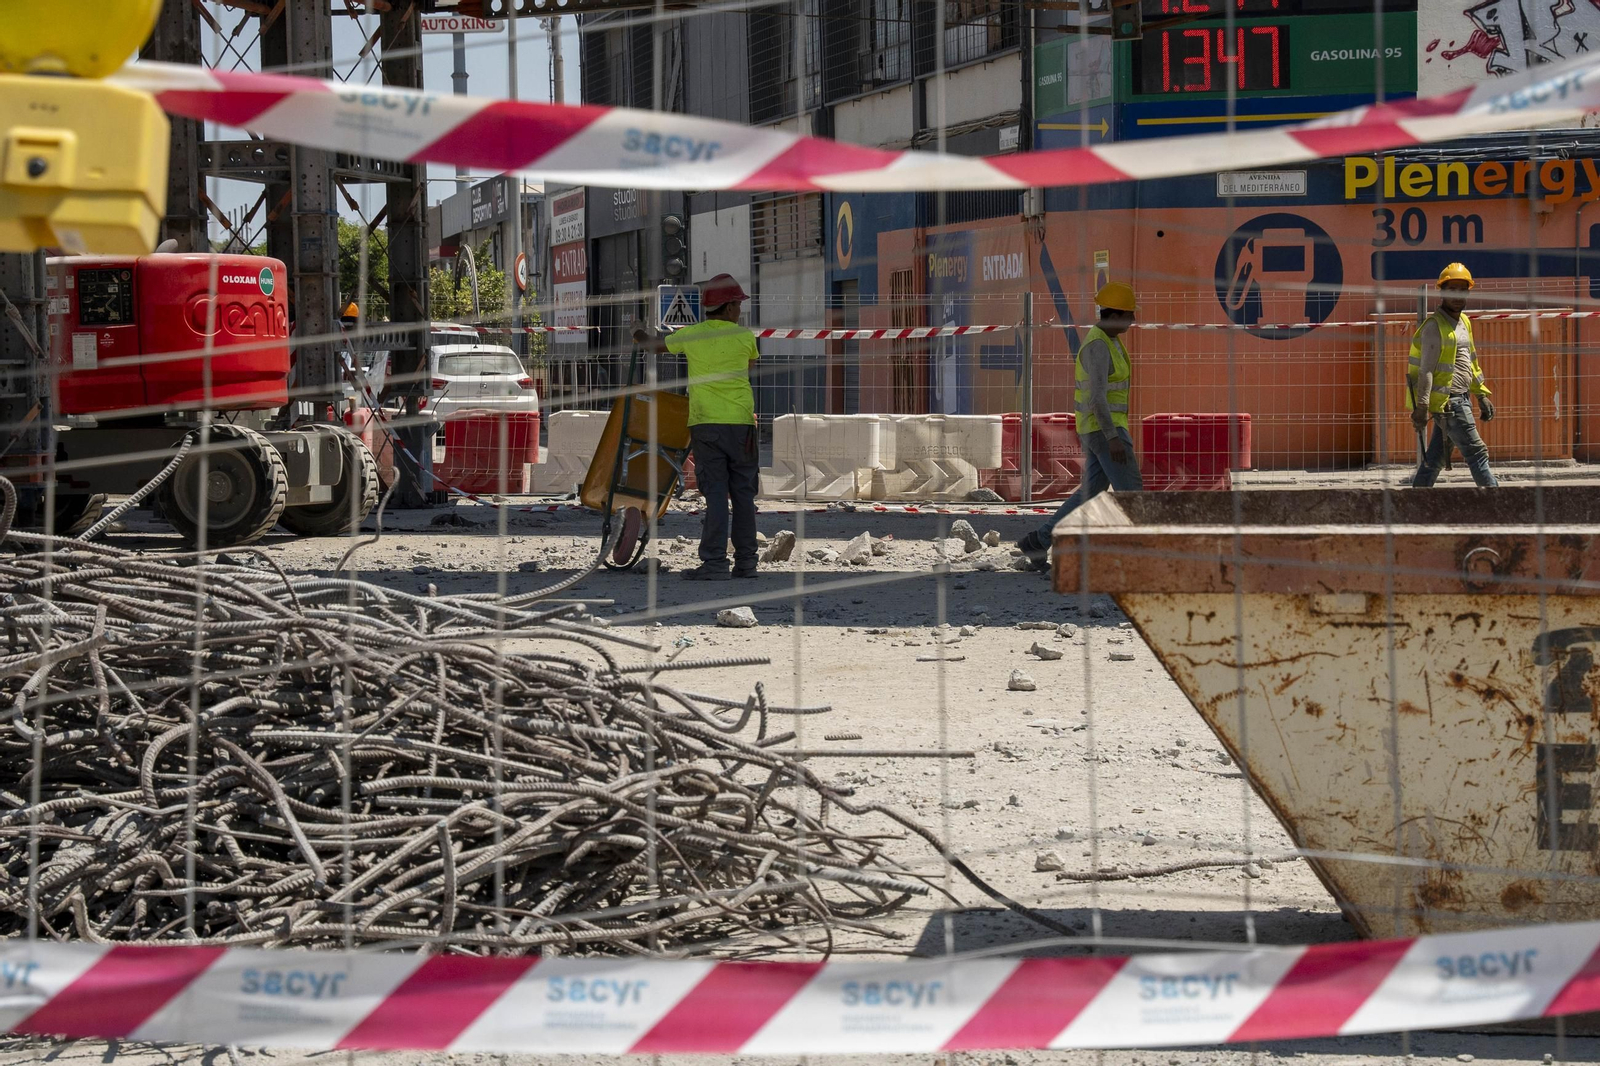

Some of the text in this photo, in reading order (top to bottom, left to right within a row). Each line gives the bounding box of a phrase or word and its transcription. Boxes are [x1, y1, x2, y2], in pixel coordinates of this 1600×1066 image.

[421, 17, 496, 31] AUTO KING
[1162, 27, 1280, 92] 1.347
[1310, 47, 1402, 61] GASOLINA 95
[1038, 73, 1057, 87] GASOLINA
[623, 128, 721, 163] sacyr
[613, 188, 637, 206] studio
[1223, 182, 1300, 193] DEL MEDITERRÁNEO
[1371, 207, 1483, 247] 30 m
[562, 248, 588, 277] ENTRAD
[928, 253, 968, 283] Plenergy
[983, 253, 1024, 281] ENTRADA
[1437, 948, 1538, 980] sacyr
[241, 967, 346, 1000] sacyr
[546, 975, 650, 1007] sacyr
[841, 981, 943, 1009] sacyr
[1140, 972, 1239, 1001] sacyr
